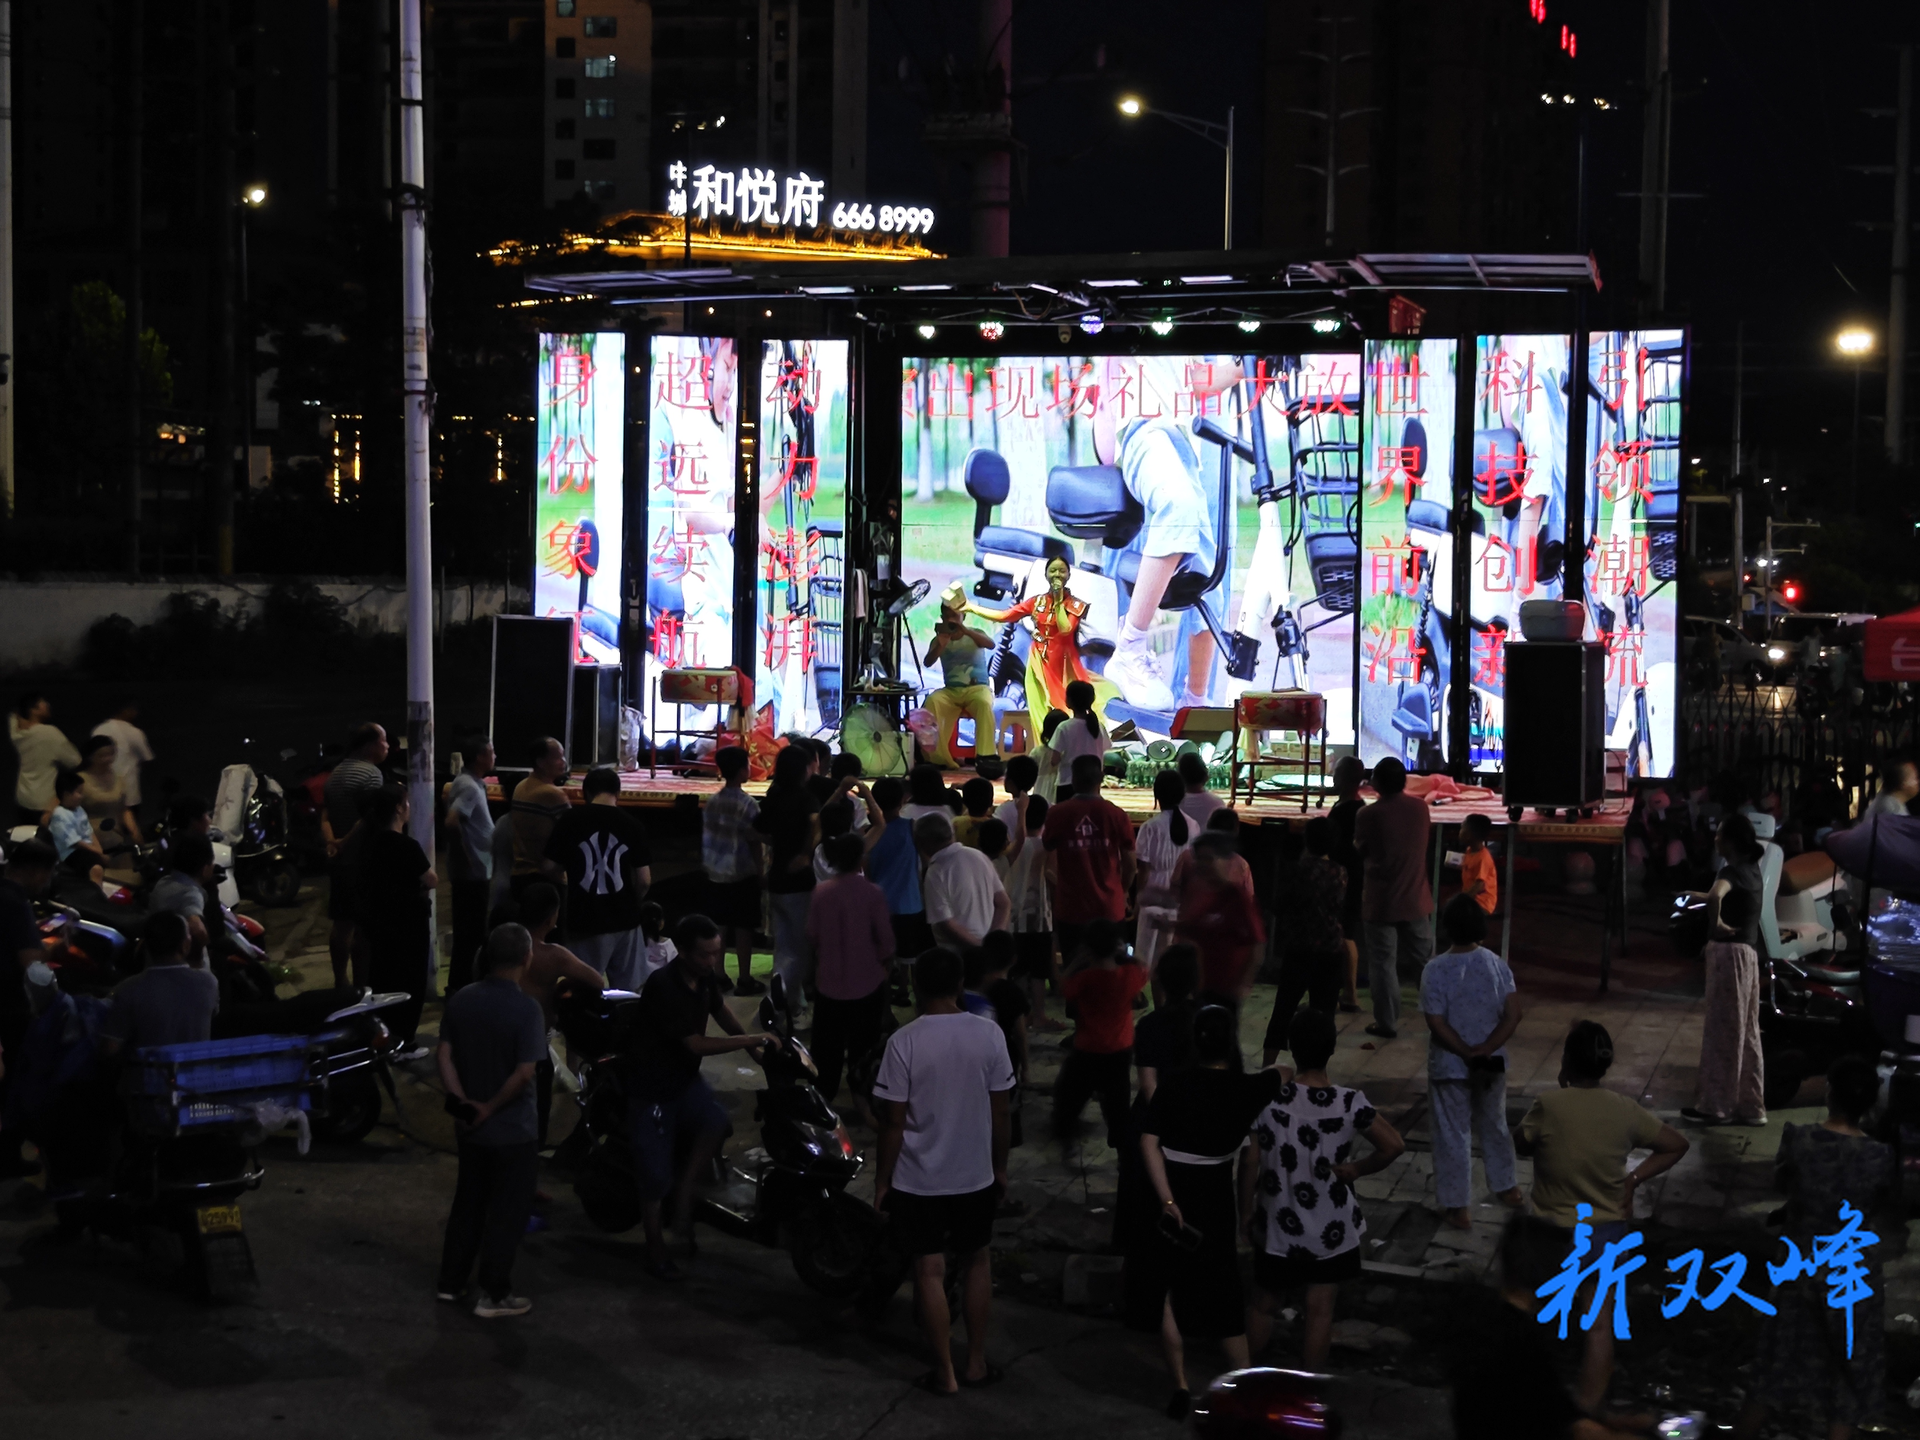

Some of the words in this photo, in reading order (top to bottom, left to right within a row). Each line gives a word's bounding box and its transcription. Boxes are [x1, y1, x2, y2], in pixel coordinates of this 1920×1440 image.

[692, 163, 825, 229] 和悦府
[832, 201, 876, 231] 666
[878, 204, 935, 234] 8999
[649, 351, 714, 669] 超远续航
[761, 350, 822, 674] 动力澎湃
[1363, 353, 1431, 686] 世界前沿
[1589, 346, 1655, 687] 引领潮流
